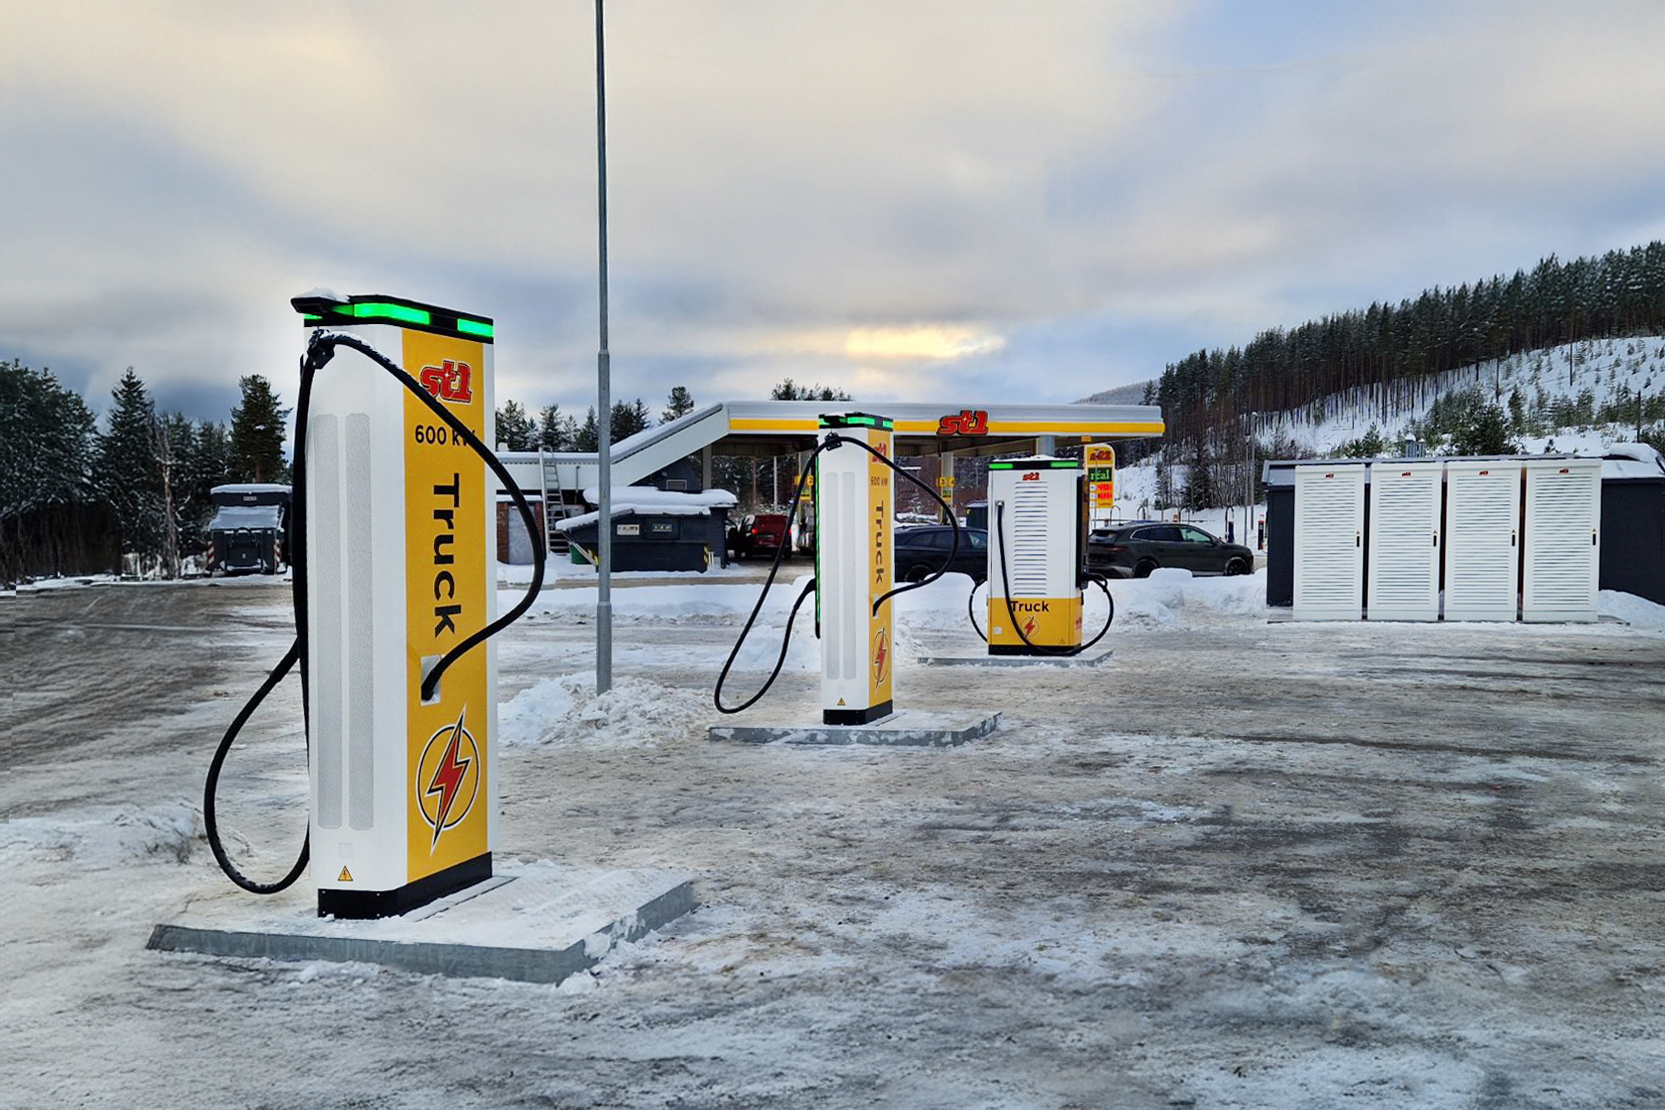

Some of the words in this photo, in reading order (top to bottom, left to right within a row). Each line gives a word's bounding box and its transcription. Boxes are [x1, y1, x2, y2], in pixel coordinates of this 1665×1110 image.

[419, 359, 474, 405] st1
[415, 424, 447, 445] 600
[452, 428, 476, 446] k
[936, 409, 989, 436] st1
[1090, 468, 1111, 480] real
[433, 473, 462, 638] Truck
[875, 500, 884, 584] Truck
[1009, 600, 1050, 612] Truck
